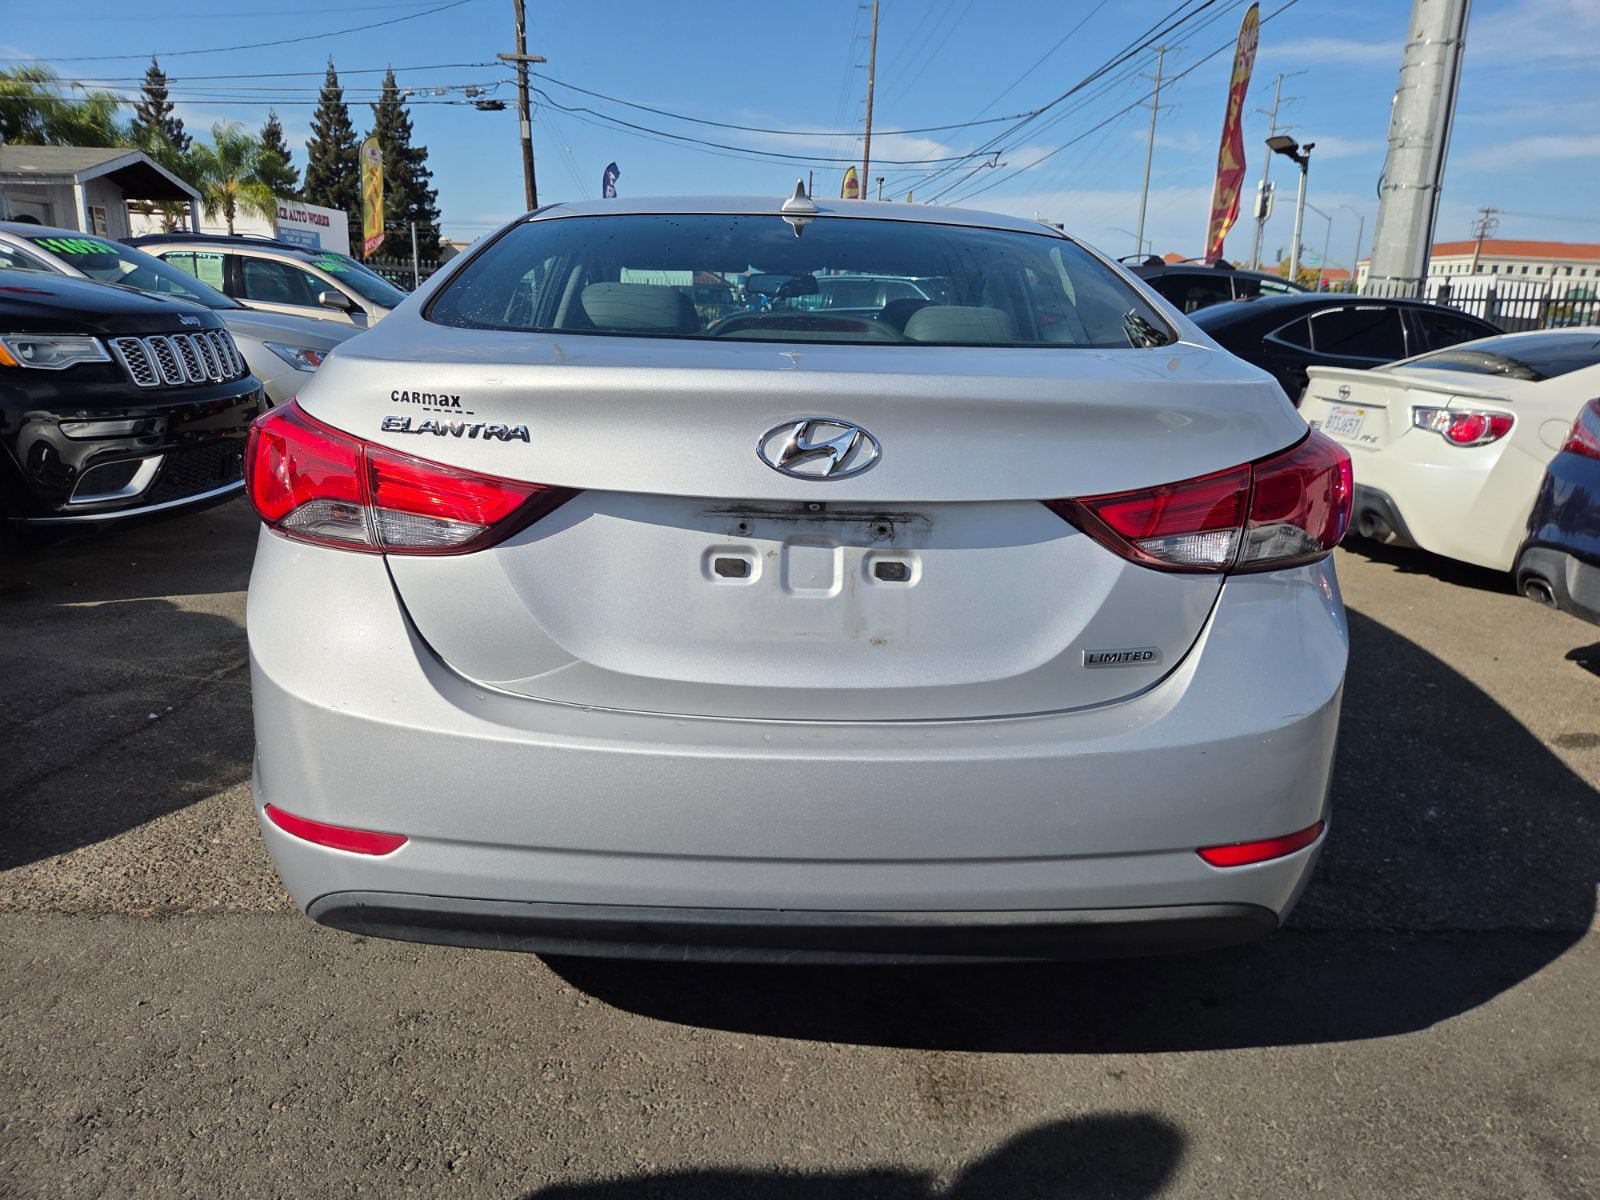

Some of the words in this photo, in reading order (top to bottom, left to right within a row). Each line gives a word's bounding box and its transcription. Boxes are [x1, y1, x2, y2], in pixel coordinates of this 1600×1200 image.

[289, 209, 307, 223] AUTO
[381, 415, 531, 443] ELANTRA
[1088, 651, 1153, 663] LIMITED
